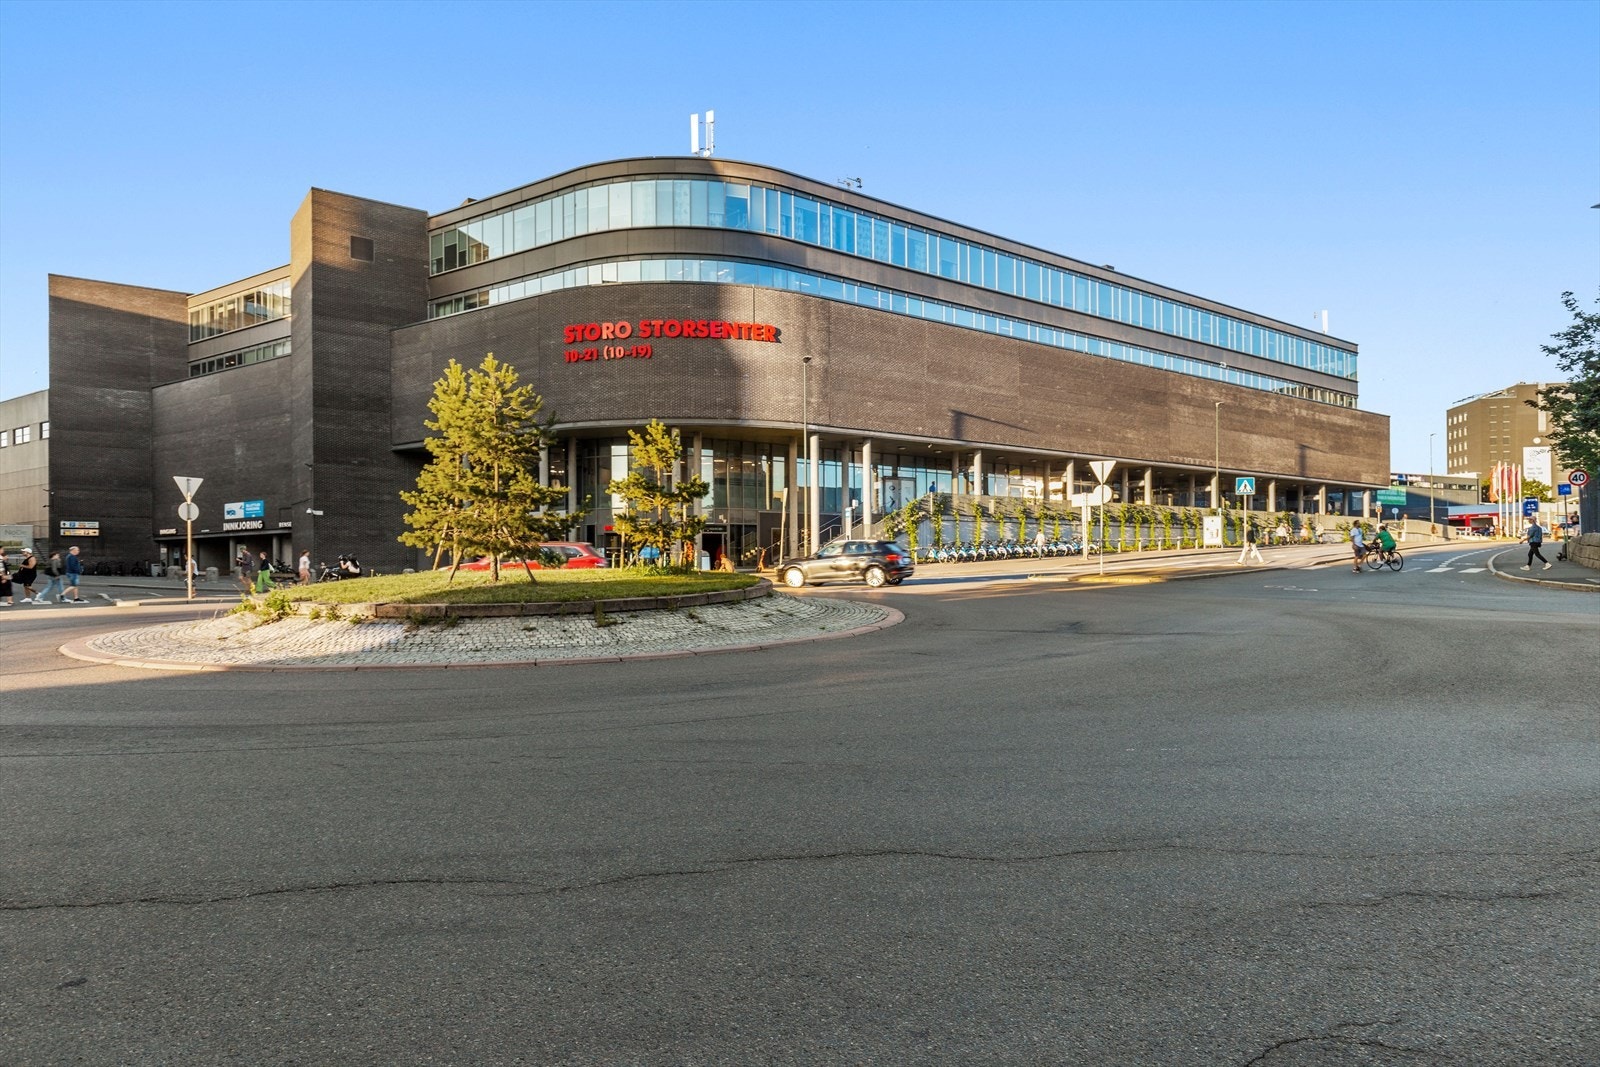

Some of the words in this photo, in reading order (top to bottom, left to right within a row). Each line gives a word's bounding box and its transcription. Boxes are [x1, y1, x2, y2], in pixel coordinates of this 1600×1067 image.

[564, 321, 632, 344] STORO
[638, 320, 776, 342] STORSENTER
[564, 348, 598, 362] 10-21
[603, 344, 653, 360] (10-19)
[1572, 473, 1585, 482] 40
